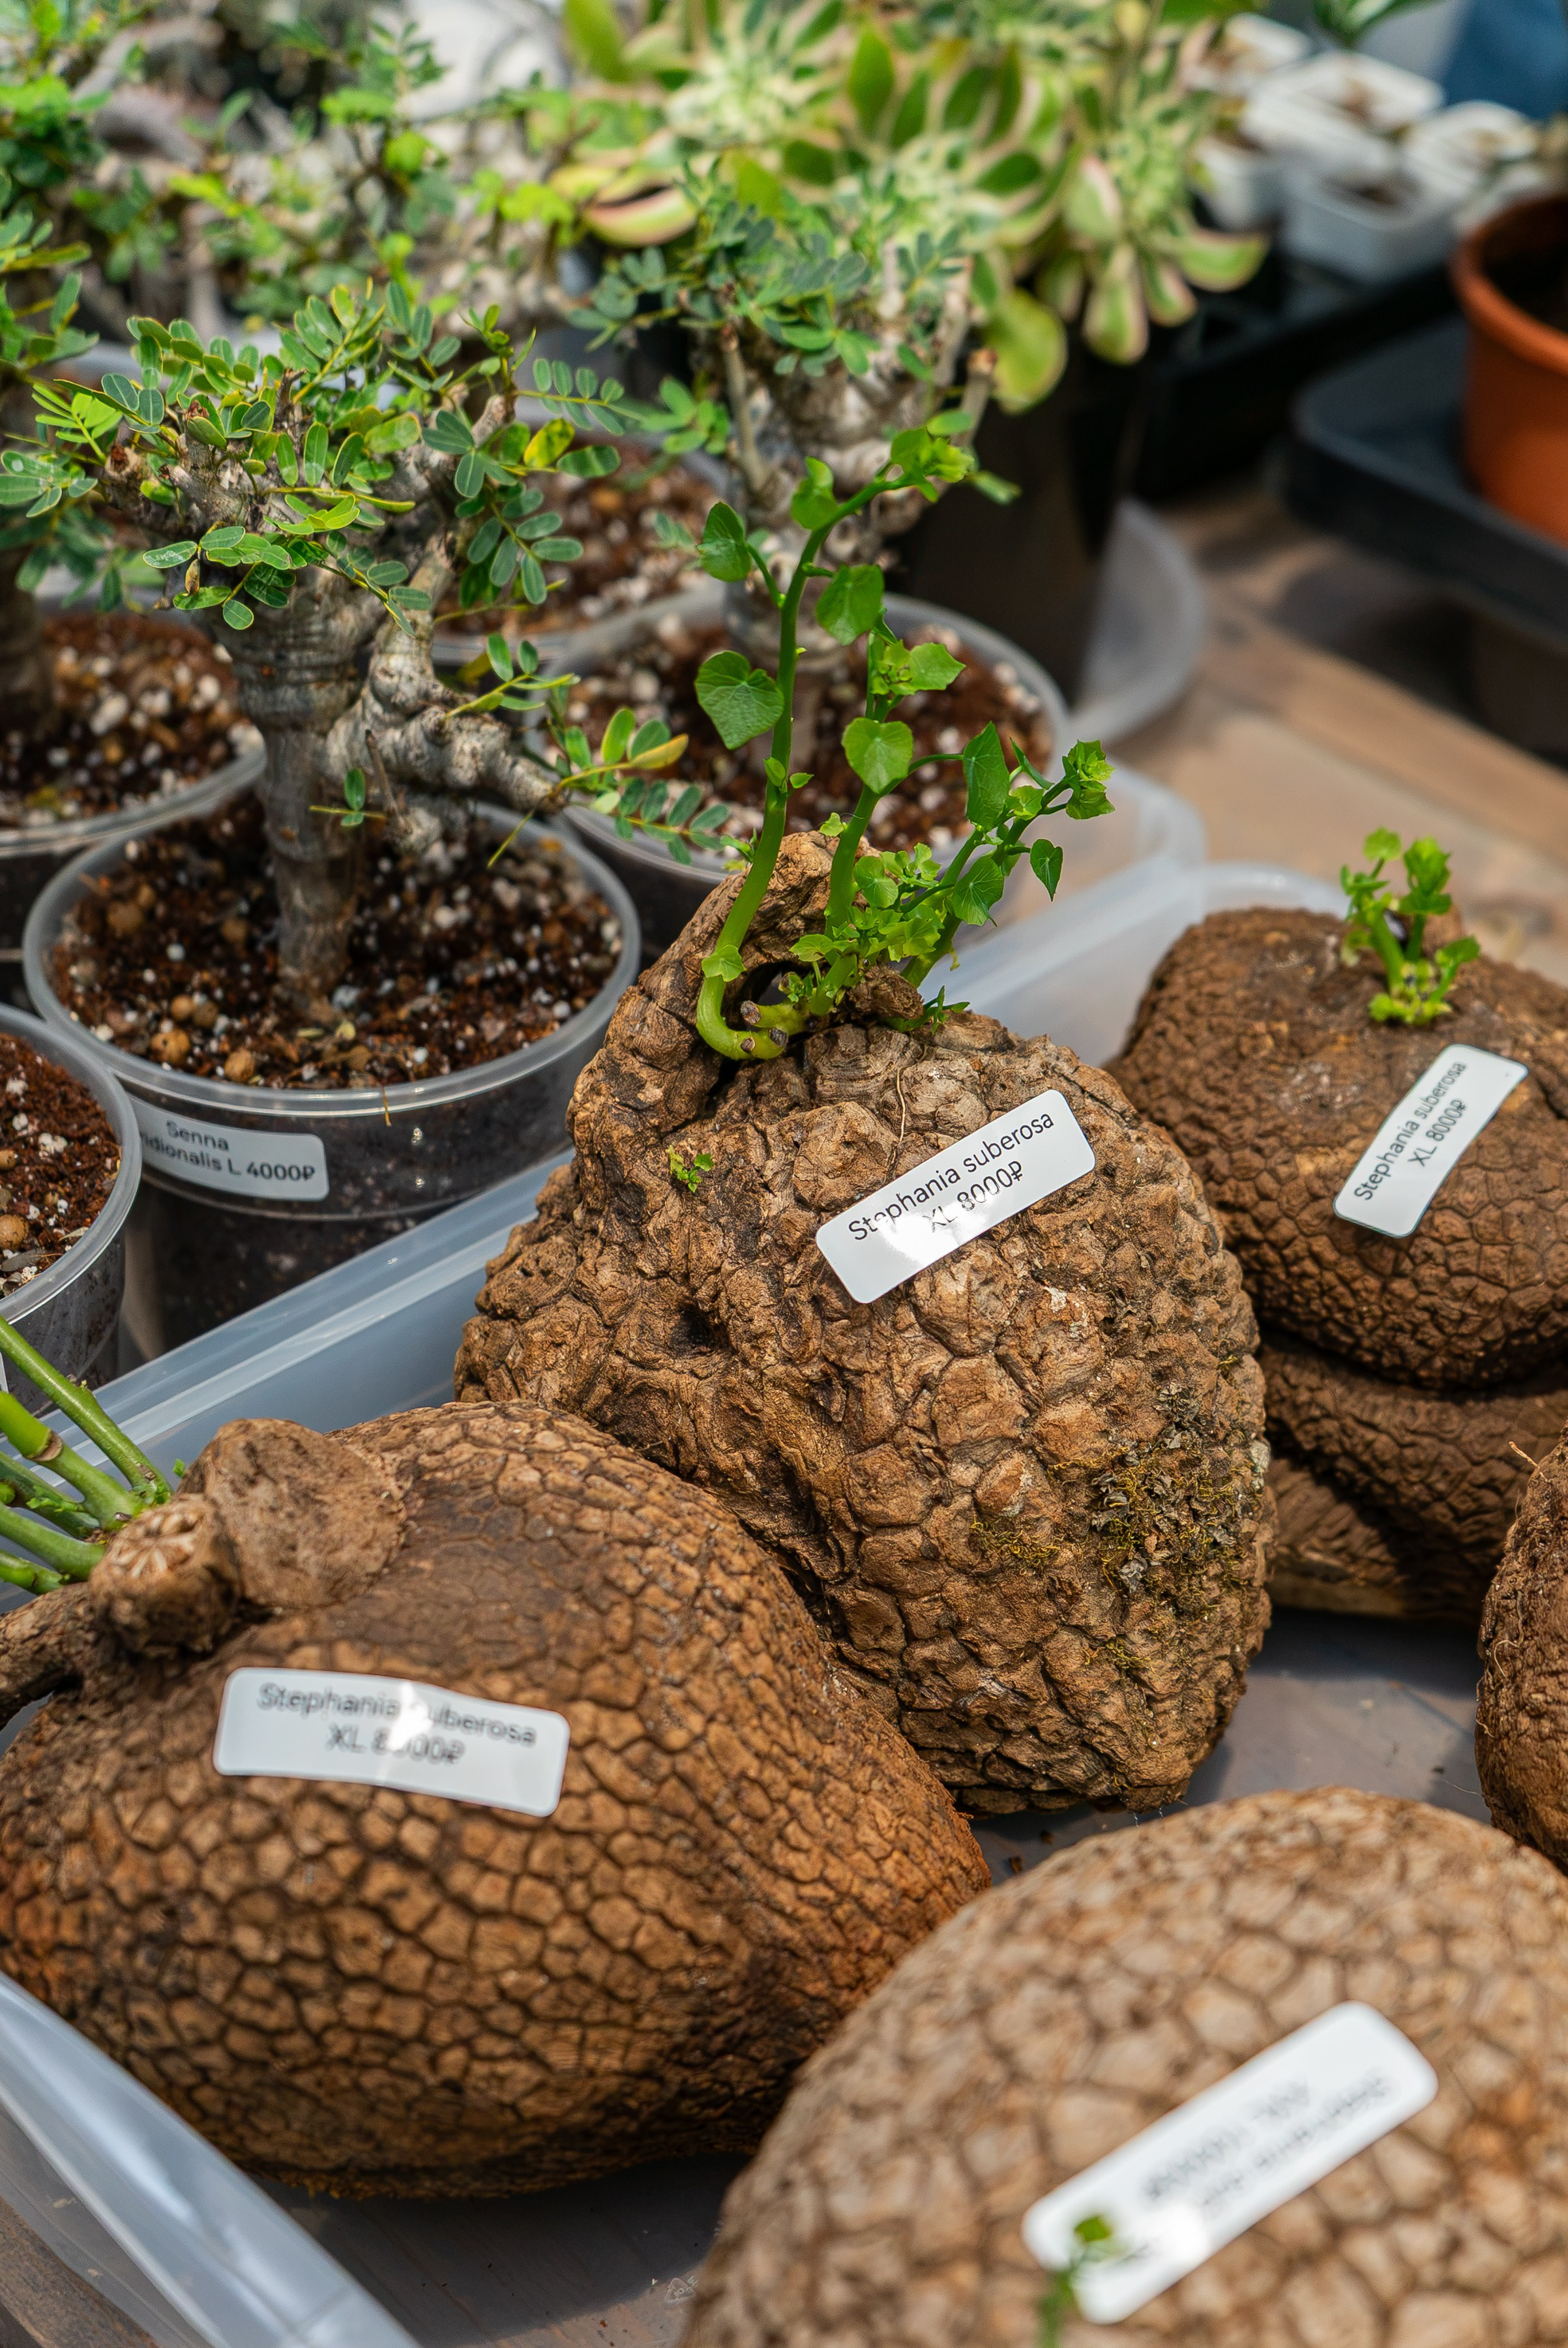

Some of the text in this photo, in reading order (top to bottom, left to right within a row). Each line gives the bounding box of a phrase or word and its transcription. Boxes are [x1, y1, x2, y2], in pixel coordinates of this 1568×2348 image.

[166, 1119, 229, 1151] Senna
[1354, 1062, 1467, 1200] Stephania suberosa
[141, 1134, 223, 1172] idionalis
[227, 1157, 242, 1175] L
[1407, 1146, 1438, 1168] XL
[848, 1112, 1055, 1241] Stephania suberosa
[922, 1205, 958, 1232] XL
[257, 1682, 537, 1747] Stephania uberosa
[326, 1722, 366, 1755] XL
